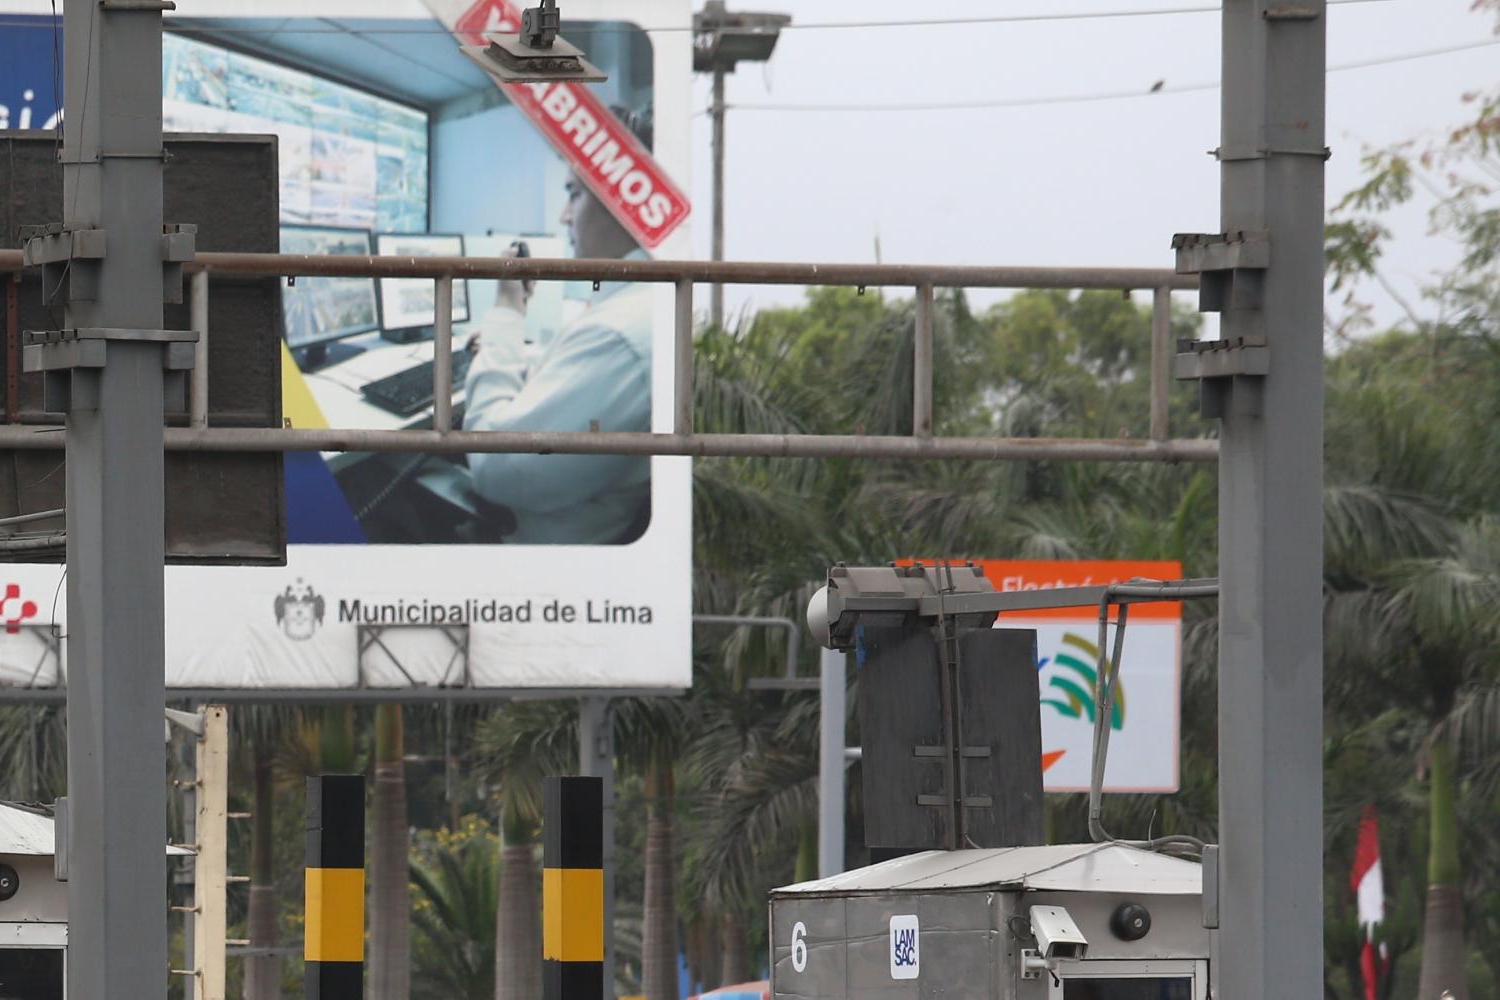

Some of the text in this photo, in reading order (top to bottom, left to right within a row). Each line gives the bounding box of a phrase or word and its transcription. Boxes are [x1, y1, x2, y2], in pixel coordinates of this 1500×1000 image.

[338, 598, 654, 625] Municipalidad de Lima
[791, 921, 807, 973] 6
[894, 928, 916, 949] LAM
